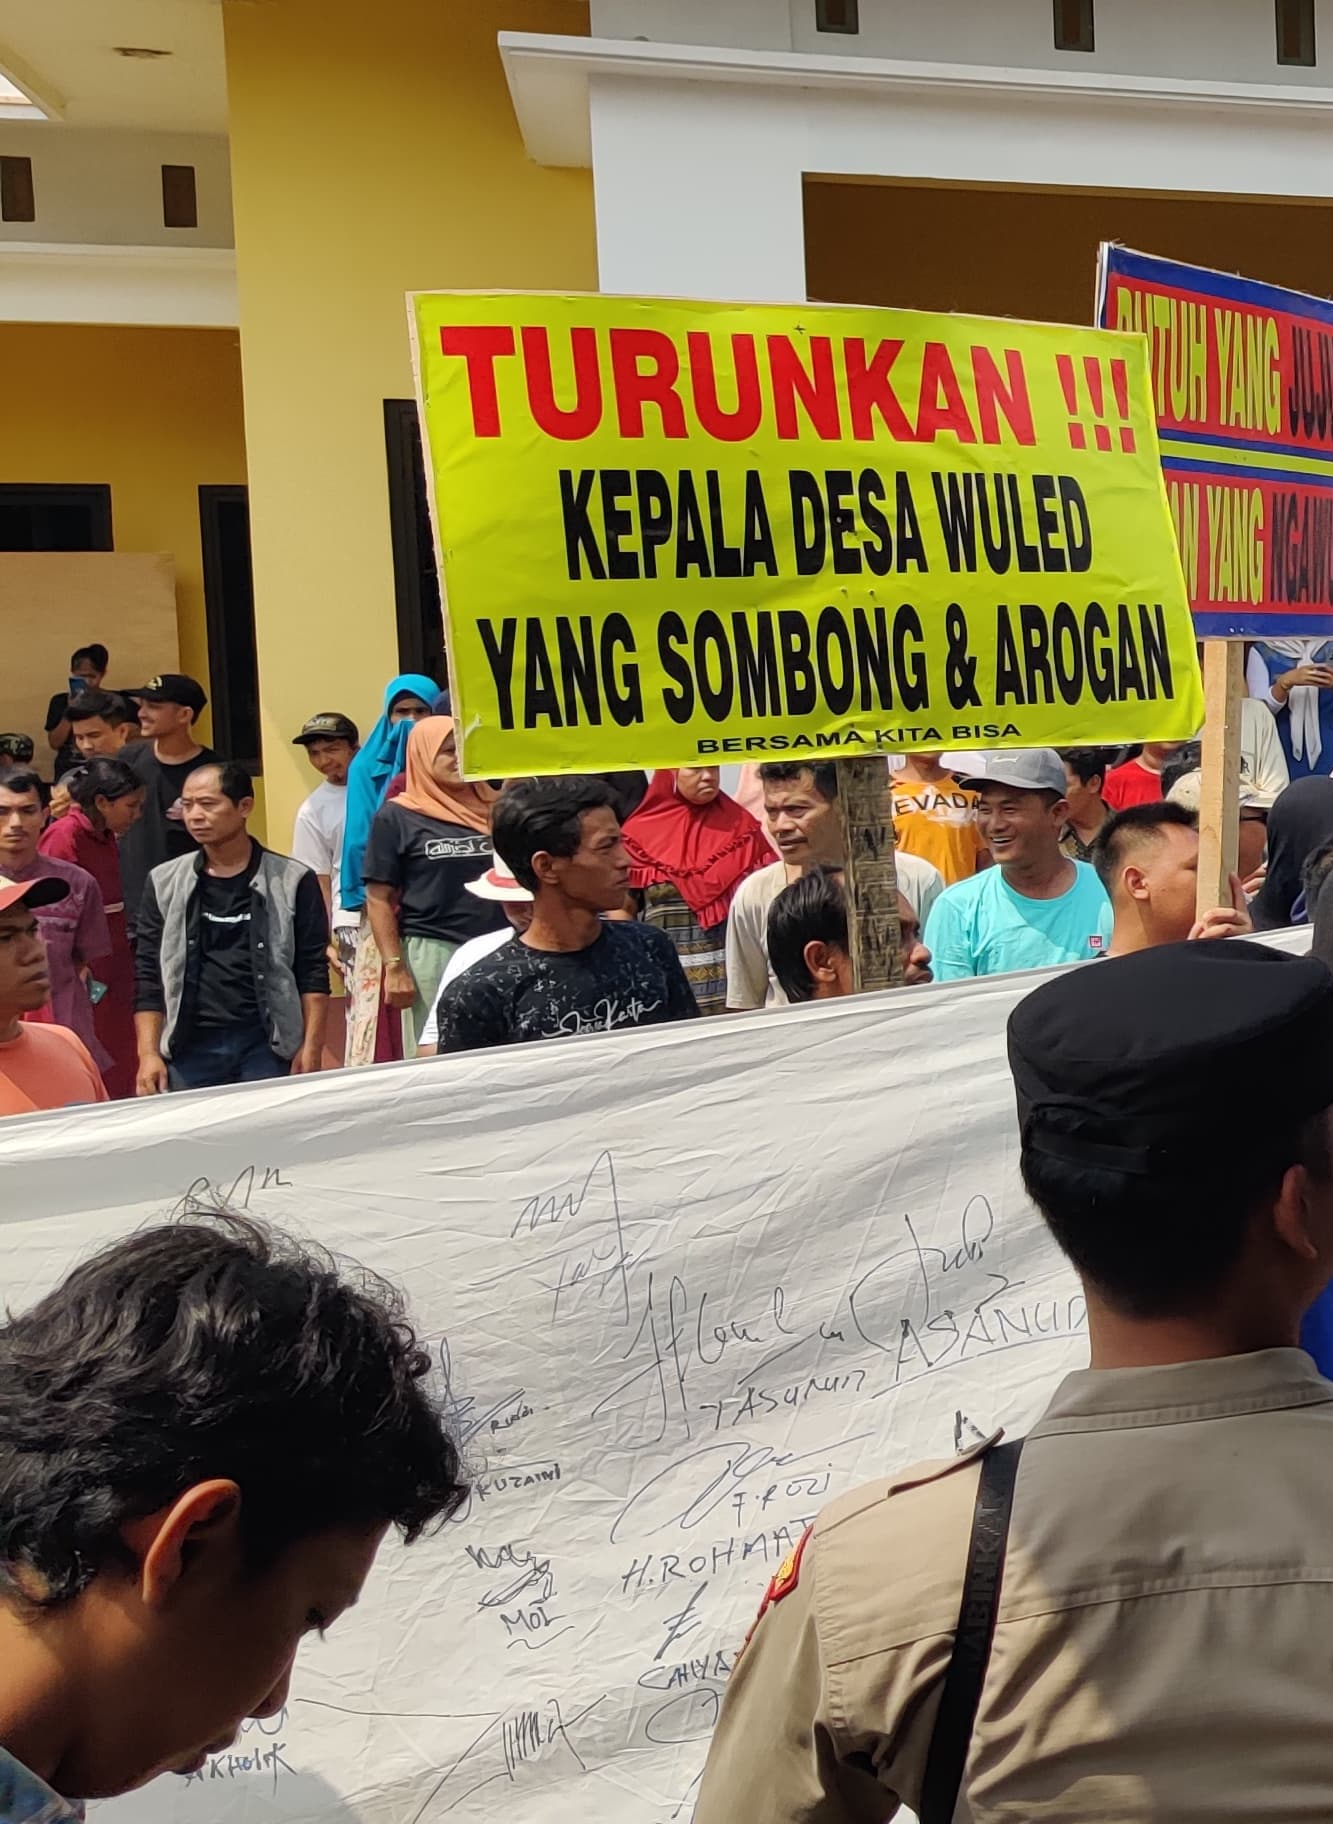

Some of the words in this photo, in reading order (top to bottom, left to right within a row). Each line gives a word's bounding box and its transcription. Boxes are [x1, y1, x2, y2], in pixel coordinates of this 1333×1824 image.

[441, 326, 1036, 447] TURUNKAN
[1056, 353, 1136, 454] !!!
[1215, 308, 1281, 436] YANG
[562, 467, 777, 581] KEPALA
[789, 467, 927, 578] DESA
[934, 474, 1092, 574] WULED
[1207, 485, 1264, 604] YANG
[476, 615, 644, 731] YANG
[662, 604, 926, 722] SOMBONG
[944, 604, 979, 710] &
[995, 603, 1175, 706] AROGAN
[697, 728, 864, 754] BERSAMA
[876, 726, 944, 745] KITA
[952, 722, 1021, 741] BISA
